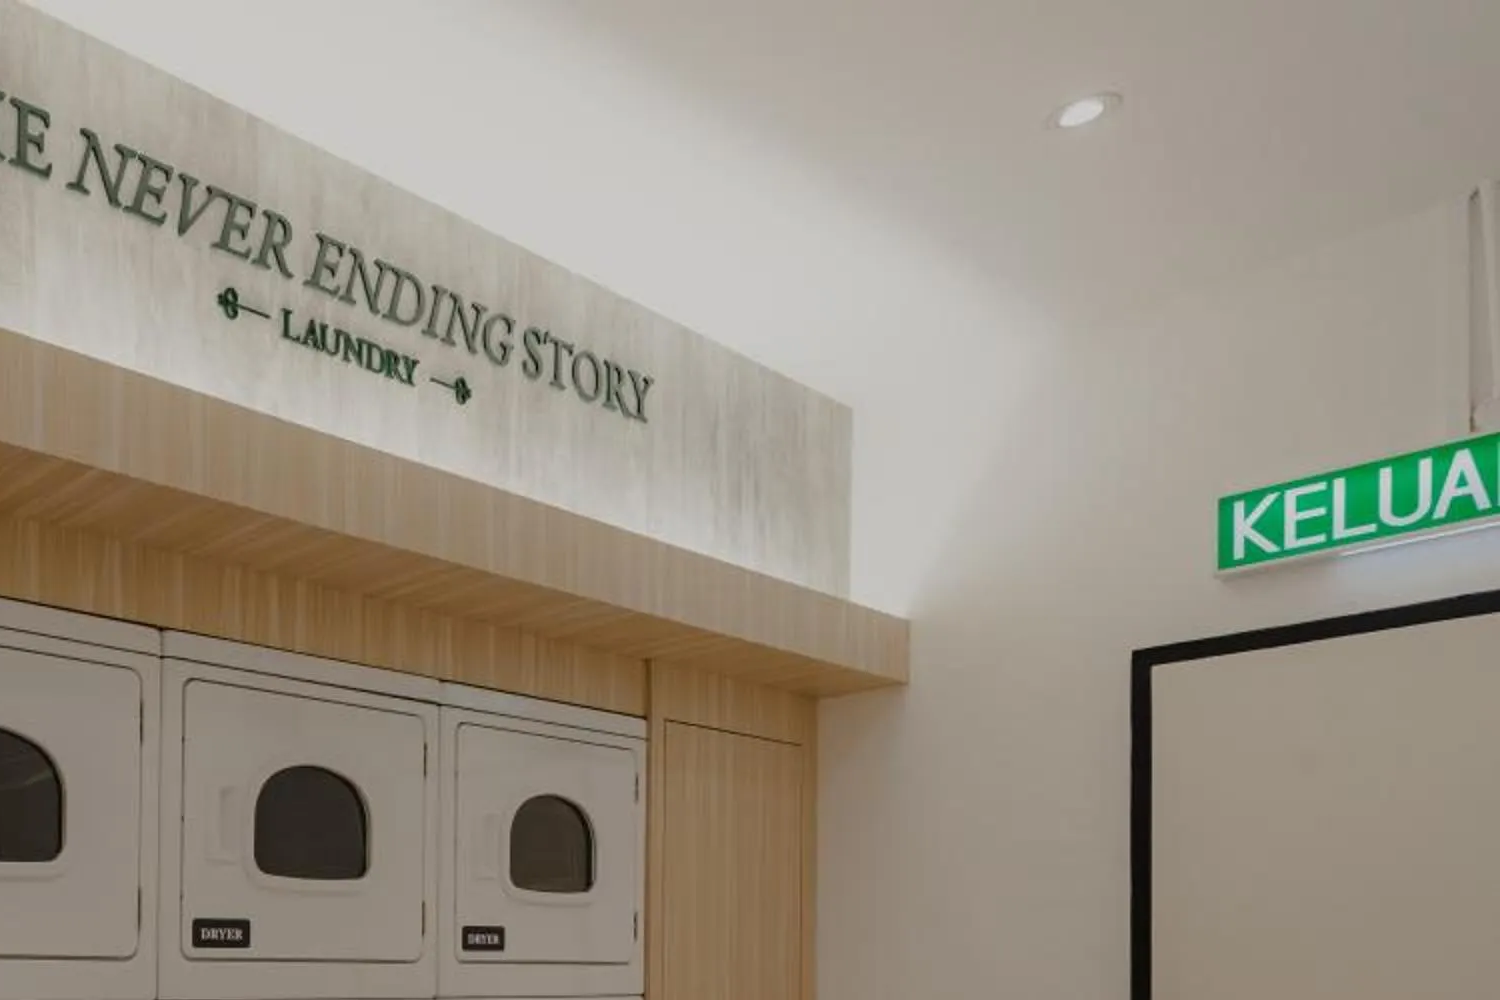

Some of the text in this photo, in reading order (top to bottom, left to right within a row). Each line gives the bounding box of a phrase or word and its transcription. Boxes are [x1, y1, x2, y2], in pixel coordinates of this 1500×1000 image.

[66, 127, 295, 279] NEVER
[304, 233, 515, 368] ENDING
[521, 327, 655, 423] STORY
[280, 309, 420, 387] LAUNDRY
[1232, 441, 1500, 561] KELUA
[200, 927, 244, 941] DRYER
